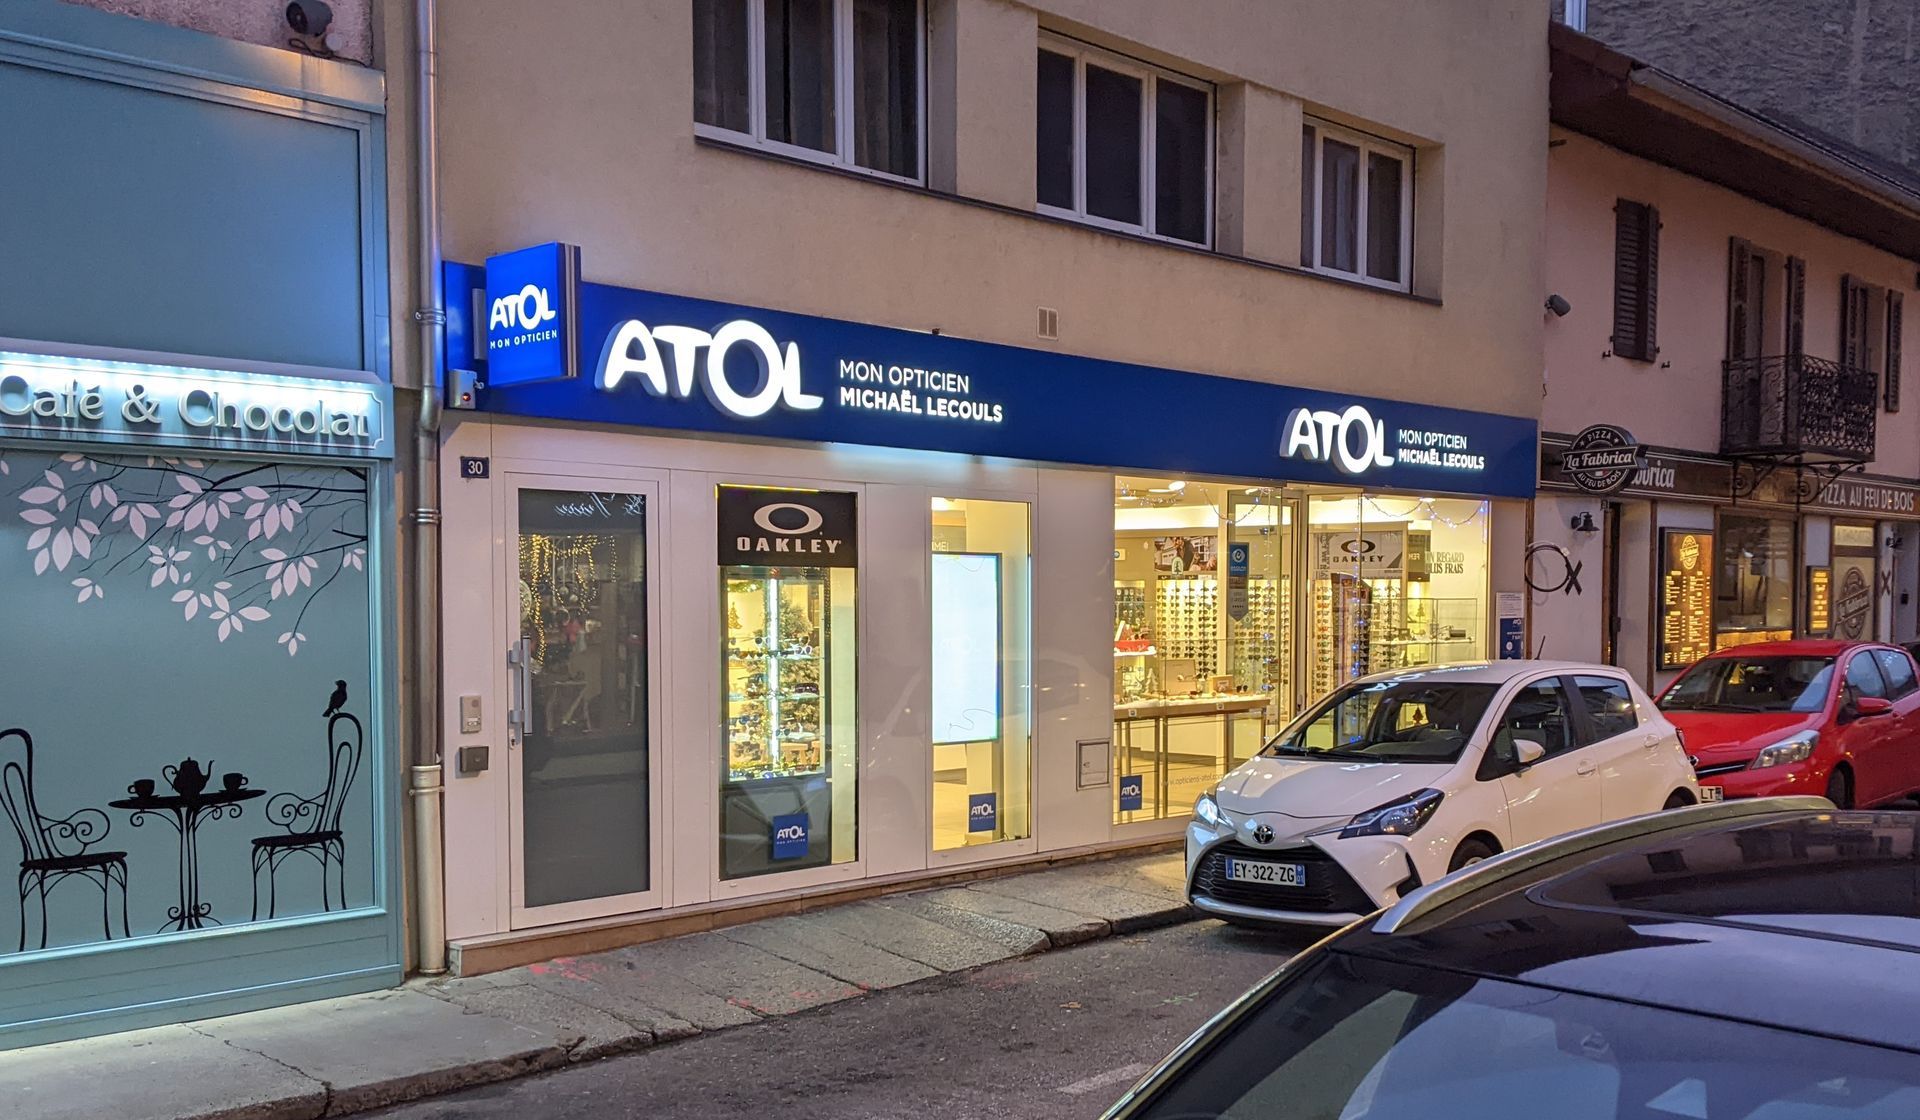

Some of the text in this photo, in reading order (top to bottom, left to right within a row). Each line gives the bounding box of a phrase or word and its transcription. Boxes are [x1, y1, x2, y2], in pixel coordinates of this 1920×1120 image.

[489, 283, 557, 331] ATOL
[489, 329, 558, 350] MON OPTICIEN
[596, 319, 824, 418] ATOL
[840, 359, 970, 394] MON OPTICIEN
[0, 375, 370, 438] Café & Chocolat
[840, 387, 1003, 423] MICHAËL LECOULS
[1280, 405, 1395, 474] ATOL
[1399, 429, 1468, 450] MON OPTICIEN
[1587, 430, 1612, 441] PIZZA
[467, 460, 483, 476] 30
[1398, 448, 1485, 470] MICHAËL LECOULS
[1565, 451, 1632, 470] La Fabbrica
[1584, 477, 1596, 488] FEU
[1606, 469, 1622, 486] BOIS
[1818, 482, 1915, 512] PIZZA AU FEU DE BOIS
[736, 536, 841, 554] OAKLEY
[1436, 551, 1465, 563] REGARD
[1444, 562, 1464, 574] FRAIS
[1121, 784, 1141, 797] ATOL
[970, 803, 994, 816] ATOL
[776, 825, 806, 840] ATOL
[1233, 861, 1295, 883] EY-322-ZG
